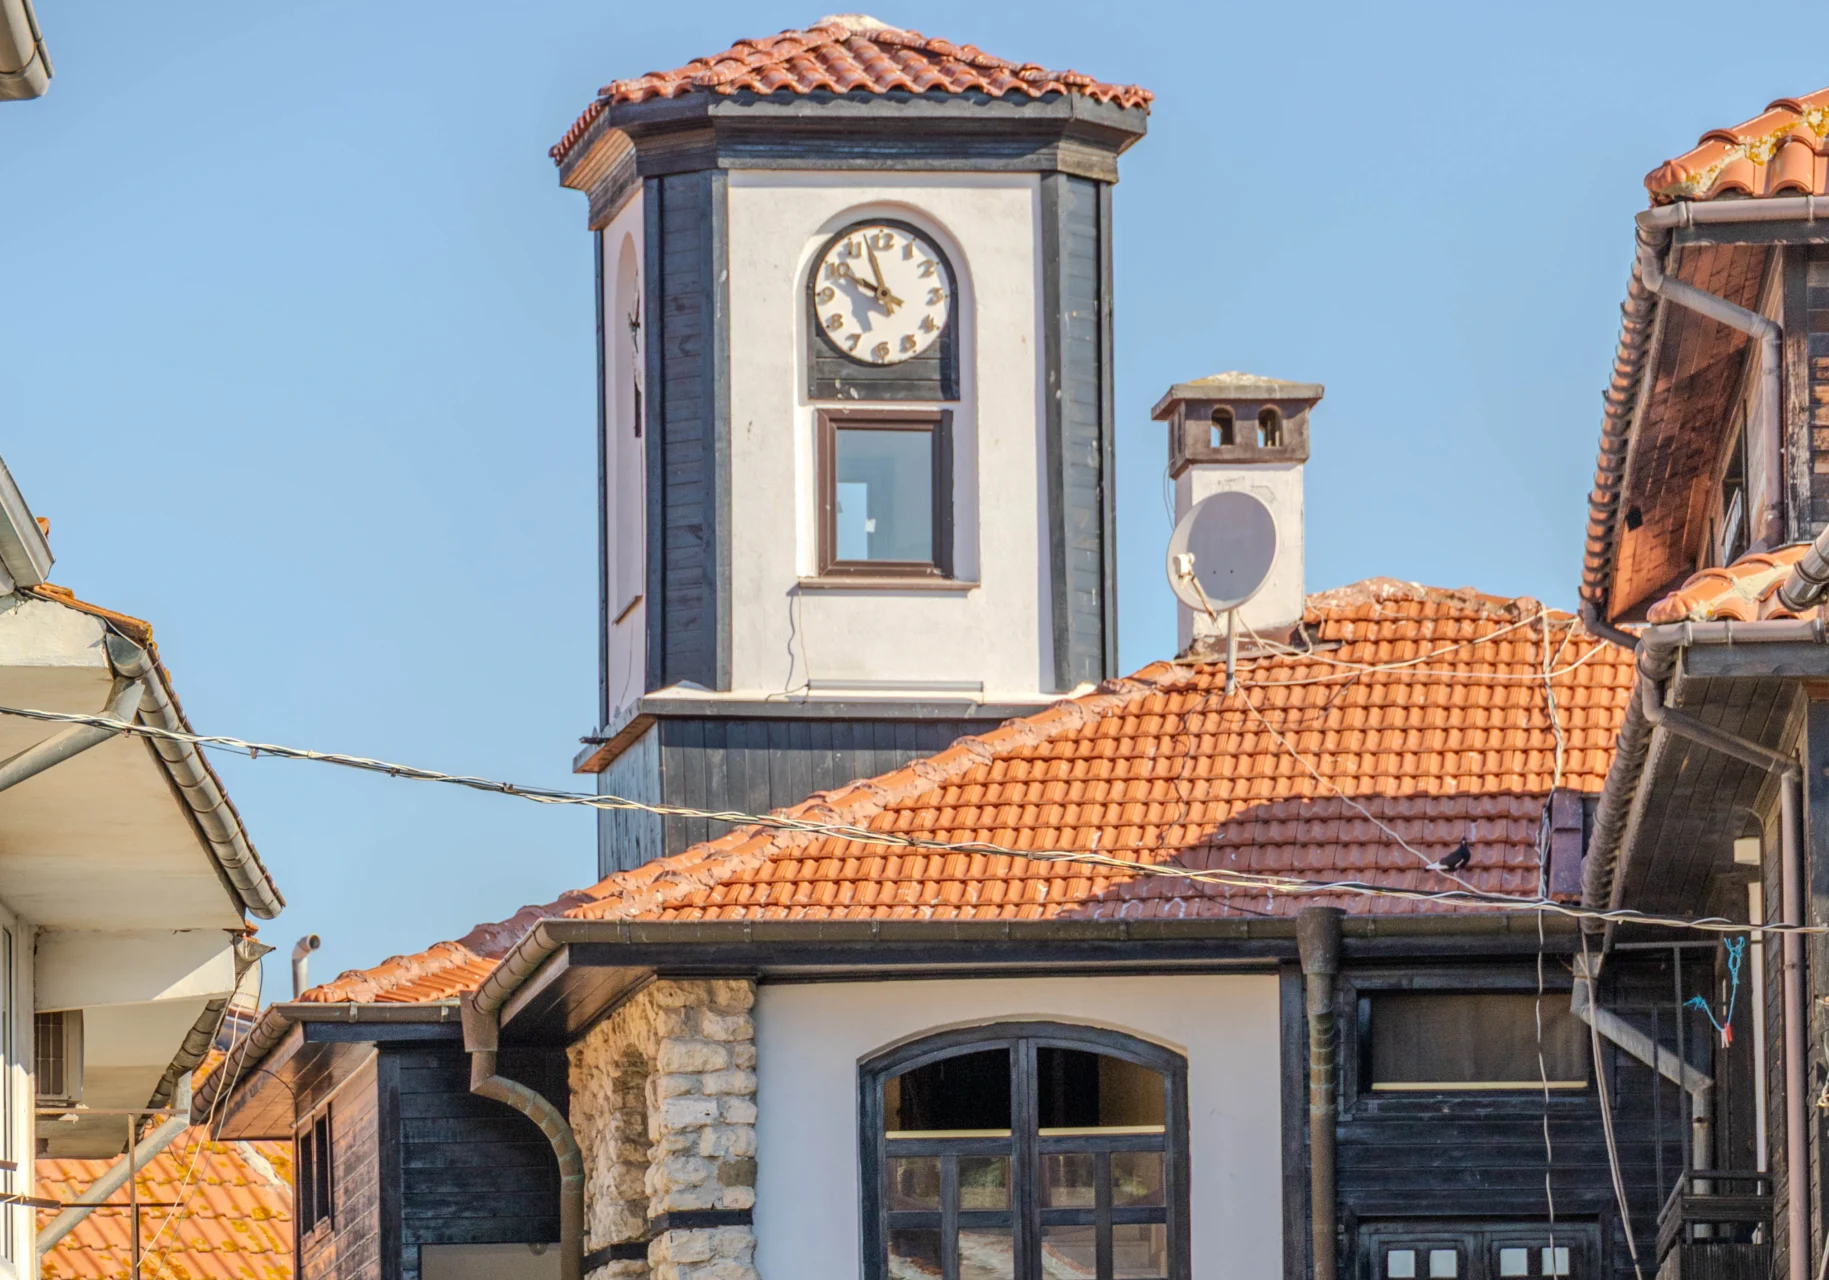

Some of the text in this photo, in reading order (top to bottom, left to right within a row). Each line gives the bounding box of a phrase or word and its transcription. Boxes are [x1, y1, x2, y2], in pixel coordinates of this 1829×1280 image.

[874, 233, 895, 249] 12
[848, 241, 862, 258] 11
[907, 243, 915, 258] 1
[828, 262, 850, 276] 10
[919, 260, 935, 277] 2
[822, 286, 835, 302] 9
[830, 313, 843, 329] 8
[846, 334, 861, 350] 7
[876, 342, 889, 358] 6
